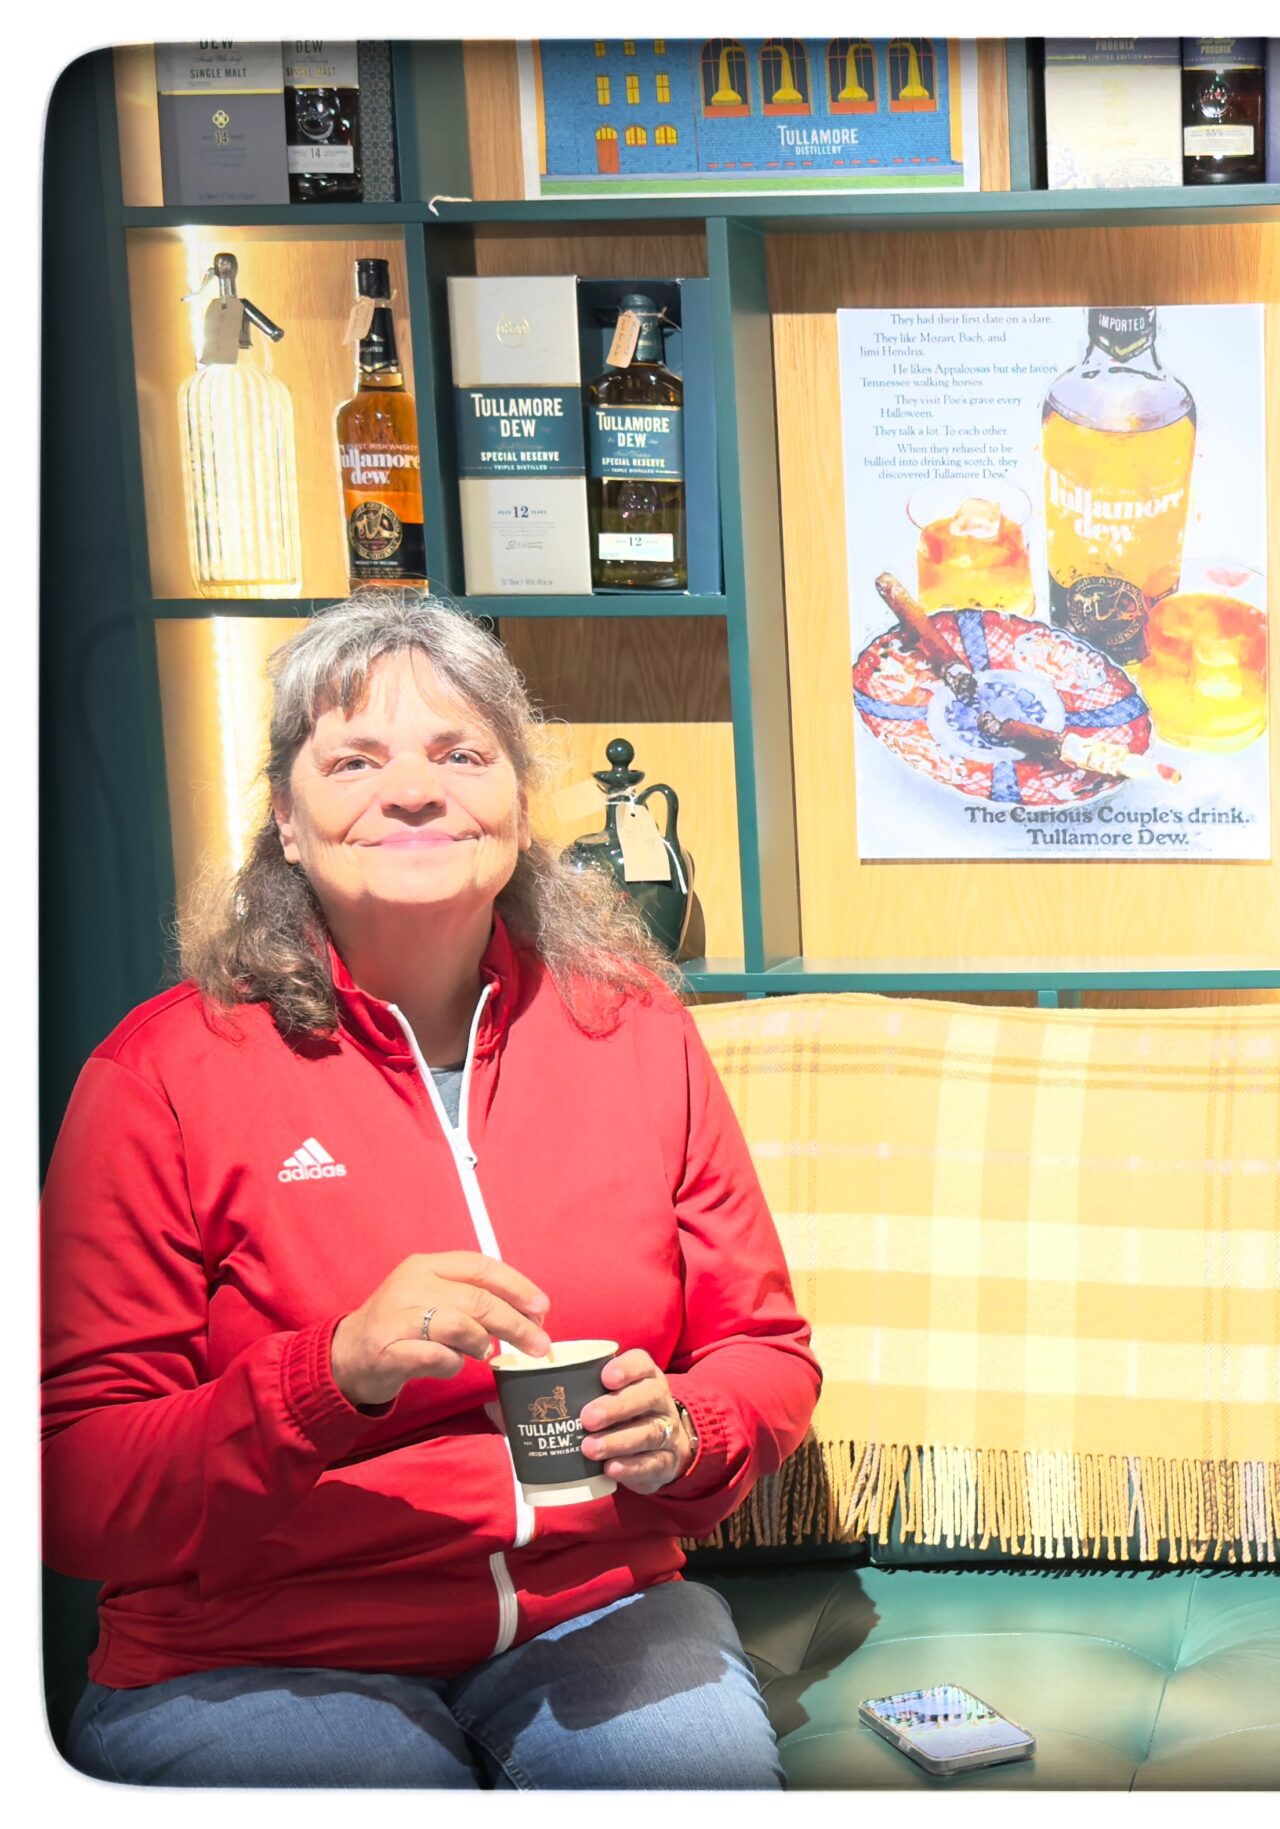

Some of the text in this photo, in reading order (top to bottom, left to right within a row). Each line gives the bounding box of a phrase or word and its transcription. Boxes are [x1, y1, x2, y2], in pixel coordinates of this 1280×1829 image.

[296, 40, 323, 54] DEW
[191, 68, 246, 78] SINGLE MALT
[214, 130, 229, 145] 14
[777, 124, 858, 146] TULLAMORE
[310, 147, 321, 159] 14
[795, 144, 843, 156] DISTILLERY
[891, 314, 913, 326] They
[917, 314, 934, 324] had
[938, 314, 959, 324] their
[962, 314, 979, 324] first
[983, 314, 1003, 324] date
[1006, 316, 1018, 324] on
[1098, 313, 1145, 332] IMPORTED
[874, 331, 1006, 345] They like Mozart, Bach, and
[860, 346, 925, 357] Jimi Hendrix.
[893, 363, 1058, 375] He likes Appaloosas but she favors
[861, 377, 910, 387] Tennessee
[914, 377, 950, 388] walking
[471, 393, 563, 417] TULLAMORE
[895, 395, 1022, 408] They visit Poe's grave every
[880, 408, 933, 418] Halloween.
[500, 419, 536, 437] DEW
[596, 411, 669, 433] TULLAMORE
[873, 425, 897, 437] They
[899, 426, 916, 436] talk
[944, 425, 955, 436] To
[958, 425, 979, 435] each
[617, 433, 647, 448] DEW
[897, 443, 1012, 455] When they refused to be
[481, 451, 559, 462] SPECIAL RESERVE
[602, 458, 665, 467] SPECIAL RESERVE
[864, 457, 896, 467] bullied
[899, 457, 918, 467] into
[920, 457, 961, 468] drinking
[998, 457, 1018, 468] they
[879, 468, 979, 479] discovered Tullamore
[514, 506, 528, 518] 12
[629, 536, 642, 547] 12
[964, 806, 1250, 827] The Curious Couple's drink.
[1027, 829, 1189, 845] Tullamore Dew.
[278, 1164, 347, 1182] adidas
[517, 1418, 583, 1437] TULLAMOR
[549, 1446, 582, 1457] WHISKE
